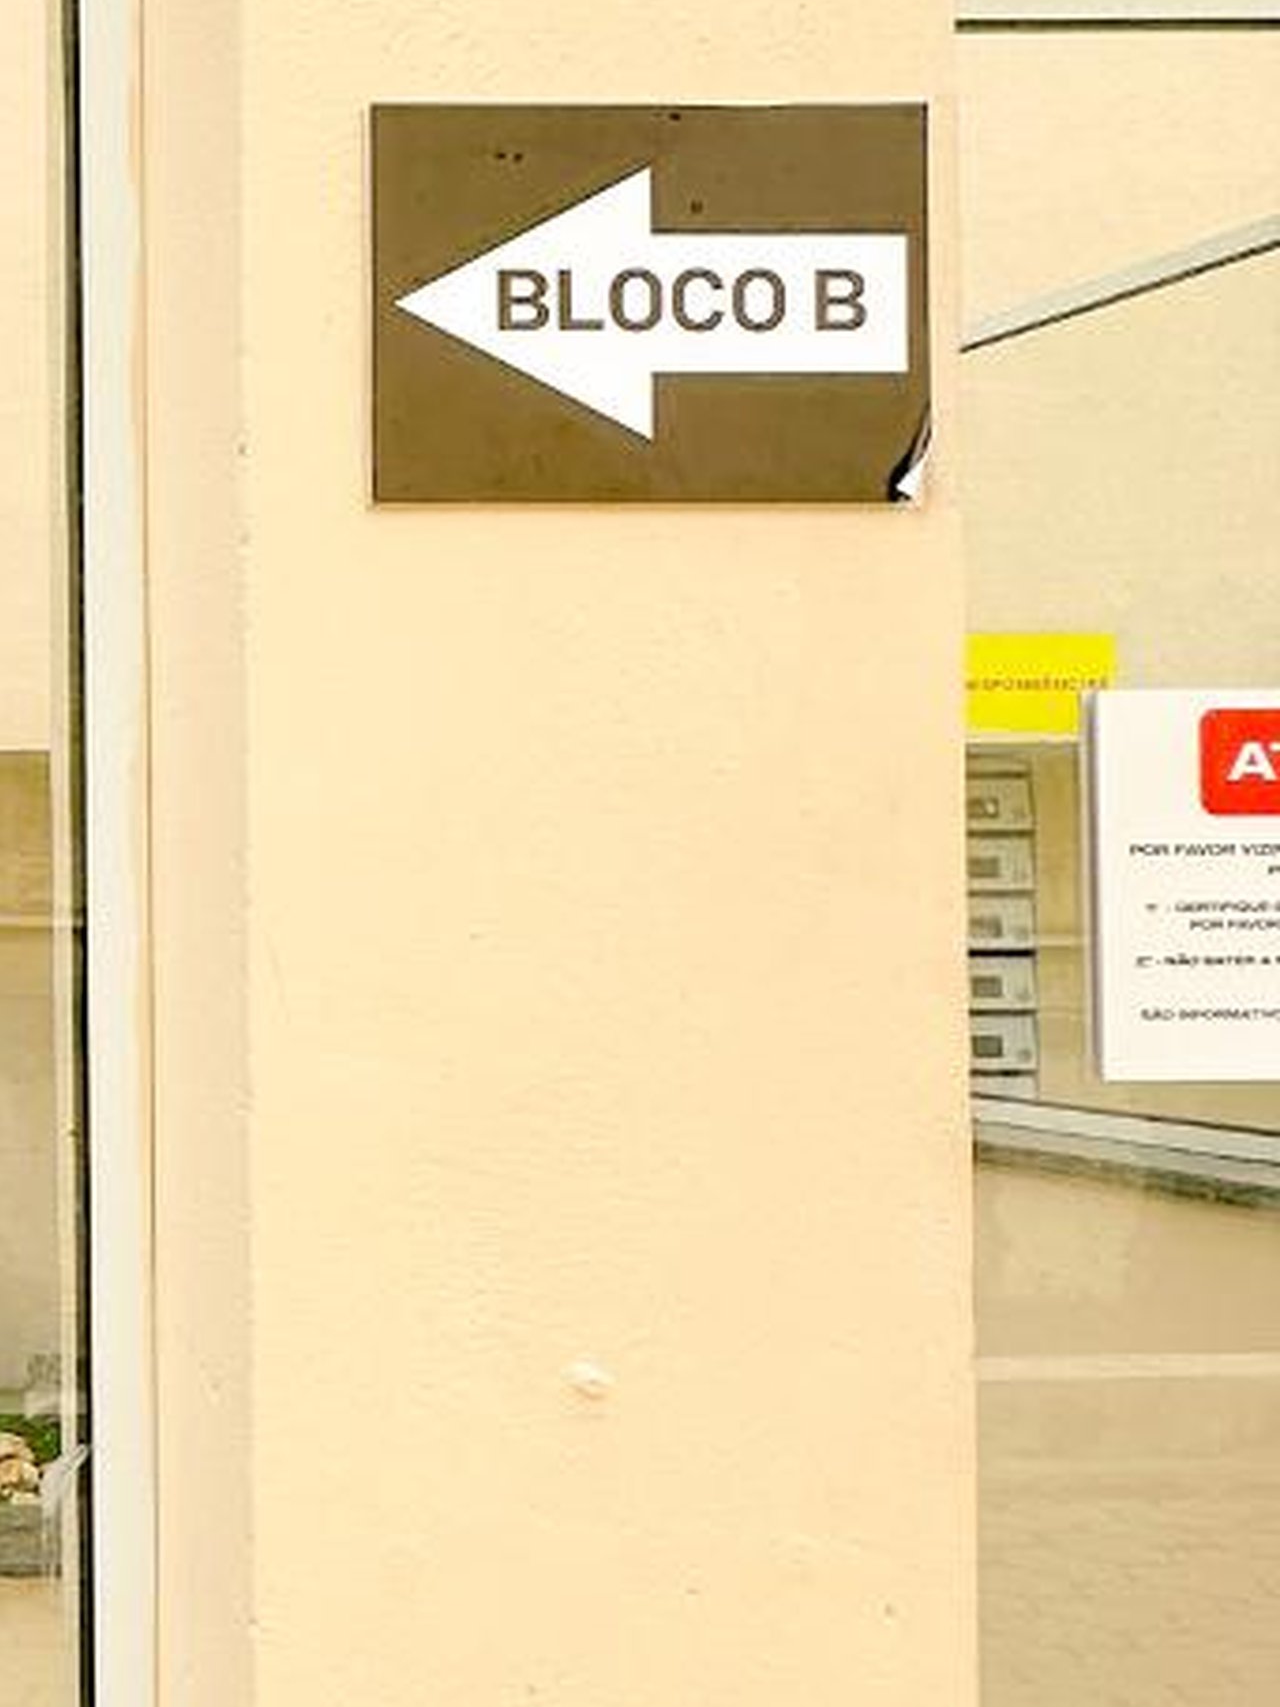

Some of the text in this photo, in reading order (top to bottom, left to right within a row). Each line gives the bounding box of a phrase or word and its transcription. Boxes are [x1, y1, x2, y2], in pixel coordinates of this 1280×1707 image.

[496, 268, 868, 333] BLOCO B
[1226, 741, 1280, 783] A
